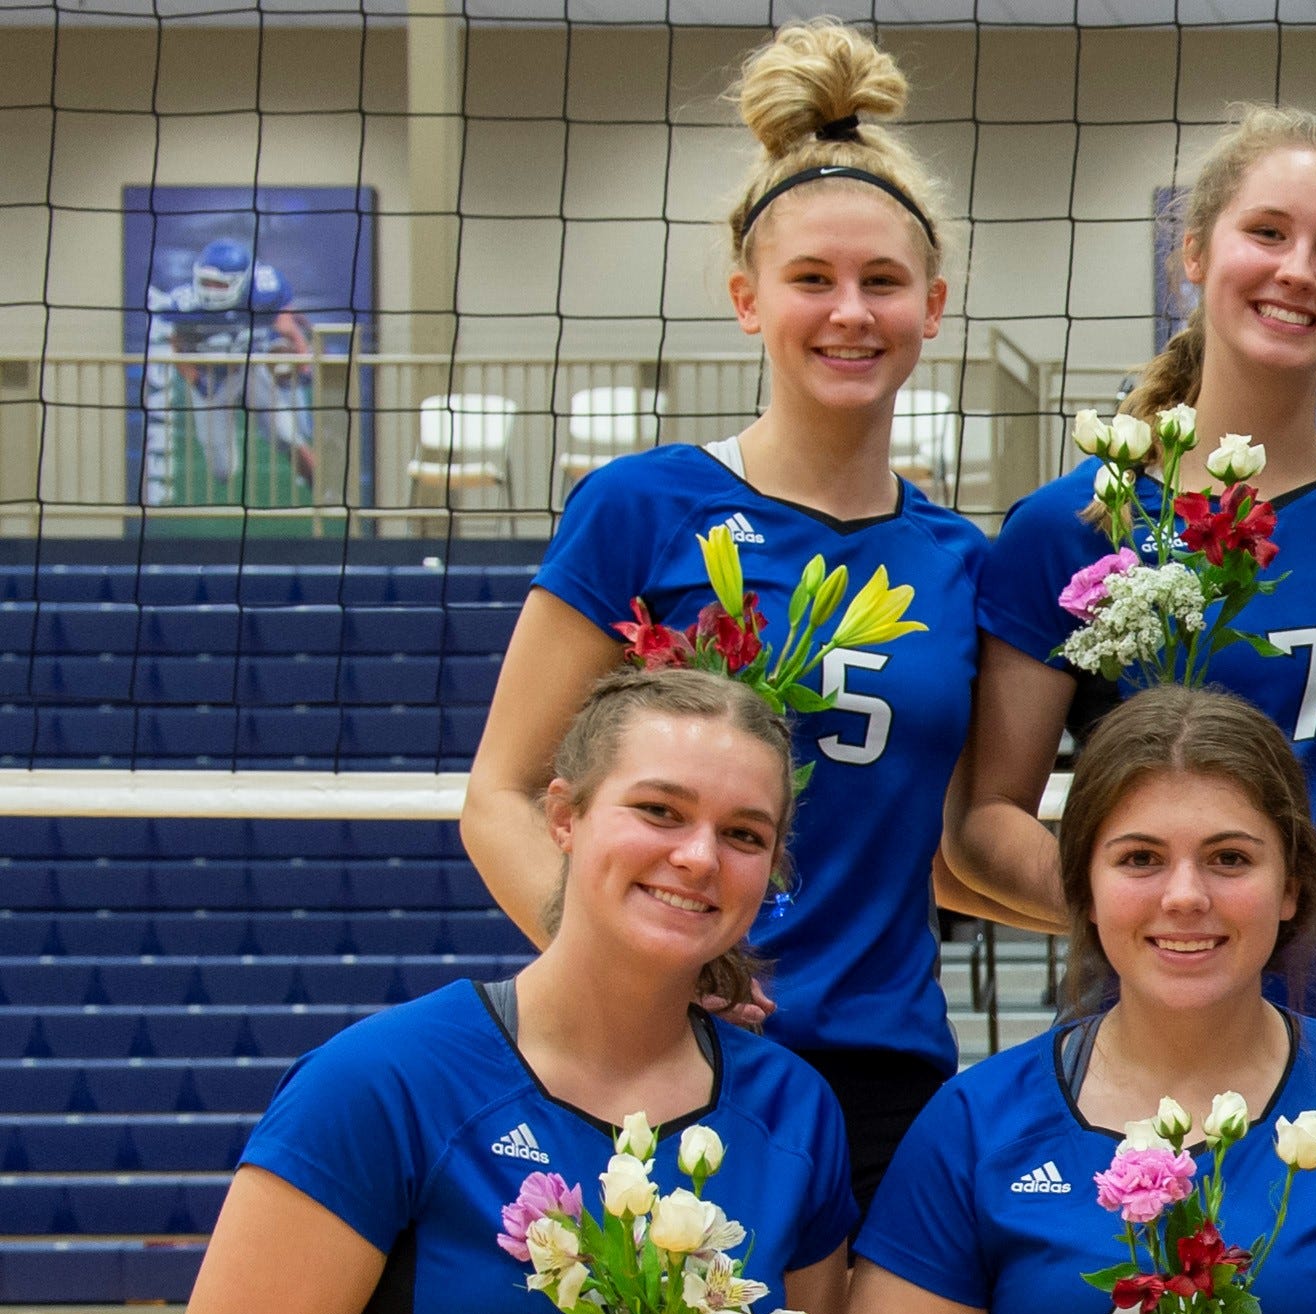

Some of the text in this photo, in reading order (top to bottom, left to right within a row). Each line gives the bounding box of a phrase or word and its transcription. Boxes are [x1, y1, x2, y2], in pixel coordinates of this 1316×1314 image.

[817, 643, 893, 765] 5
[491, 1142, 550, 1164] adidas
[1011, 1180, 1071, 1194] adidas
